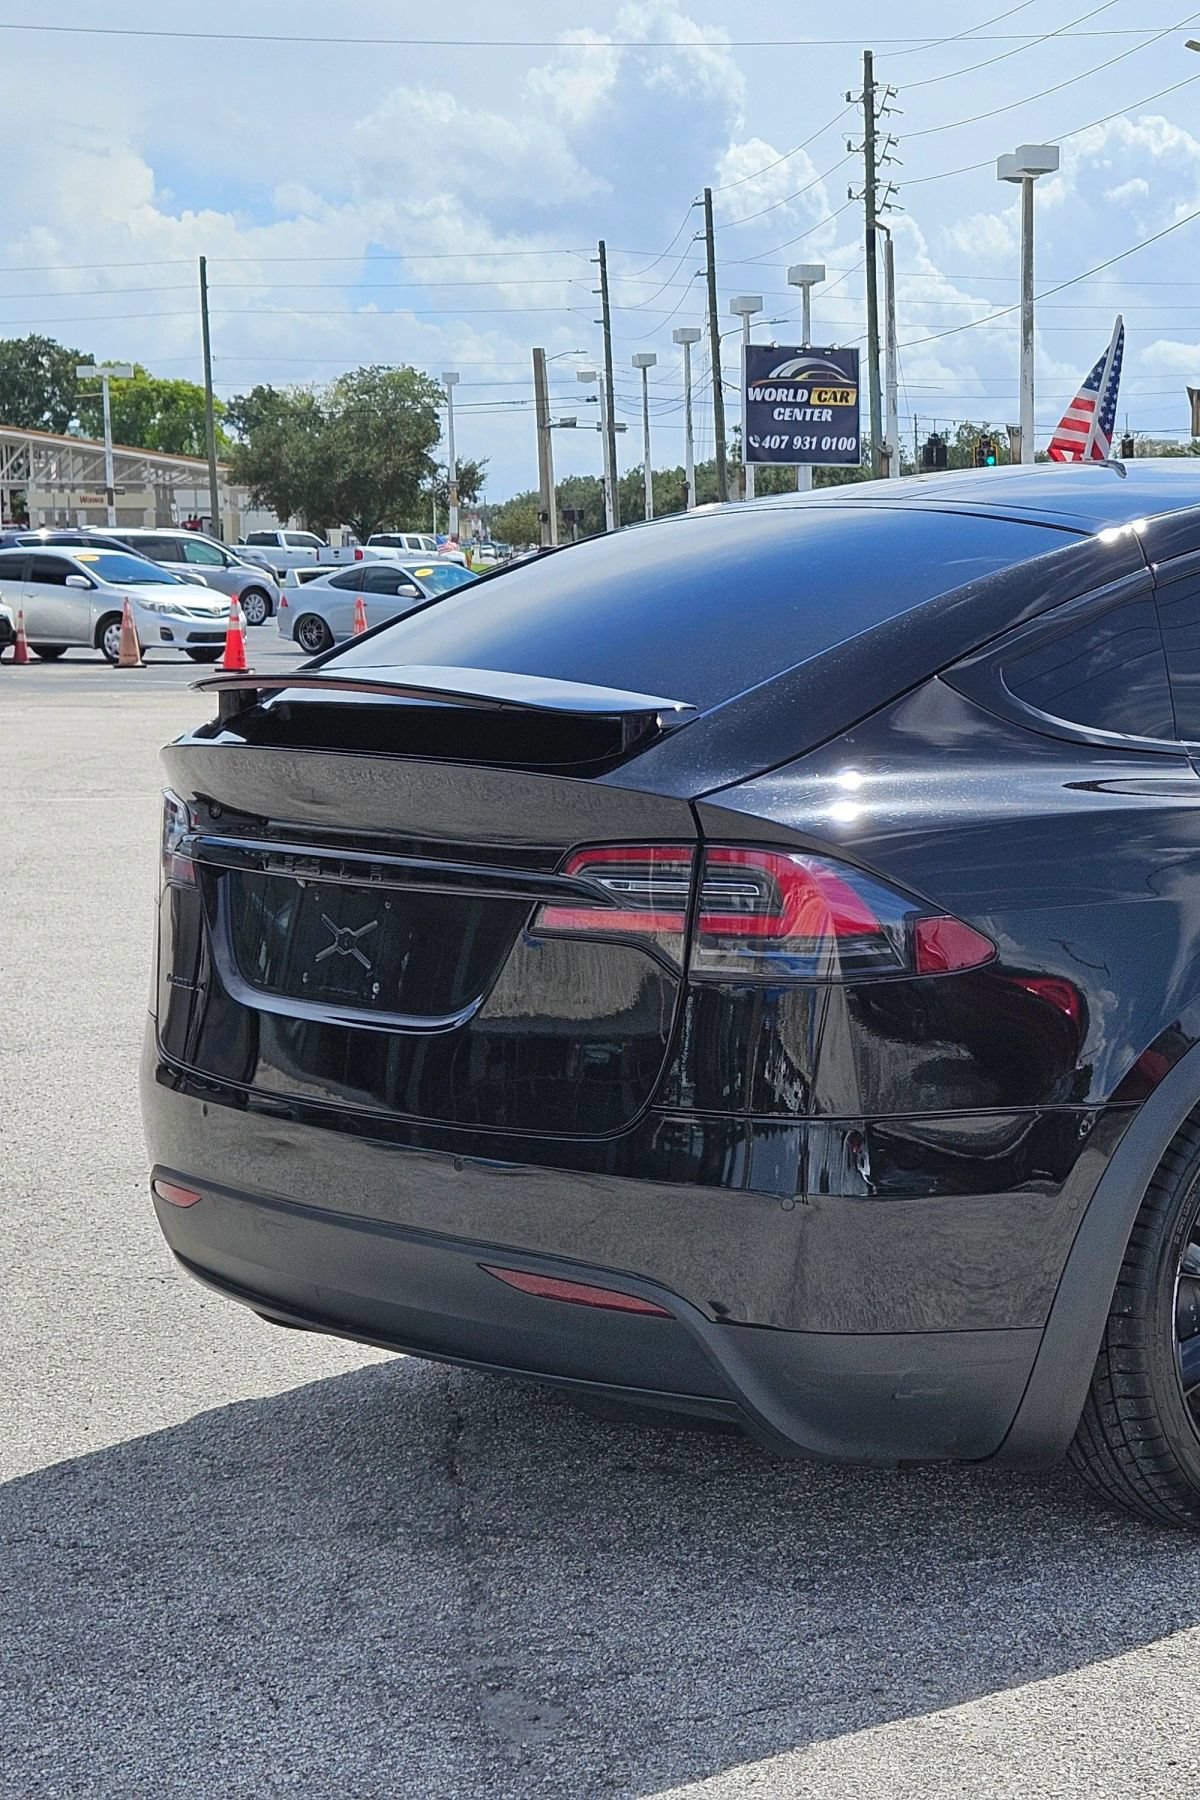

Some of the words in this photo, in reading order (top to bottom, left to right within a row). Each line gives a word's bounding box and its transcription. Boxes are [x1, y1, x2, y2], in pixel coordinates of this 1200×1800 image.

[748, 387, 809, 402] WORLD
[817, 390, 850, 403] CAR
[773, 407, 833, 422] CENTER
[761, 435, 789, 449] 407
[792, 436, 818, 450] 931
[821, 437, 857, 451] 0100
